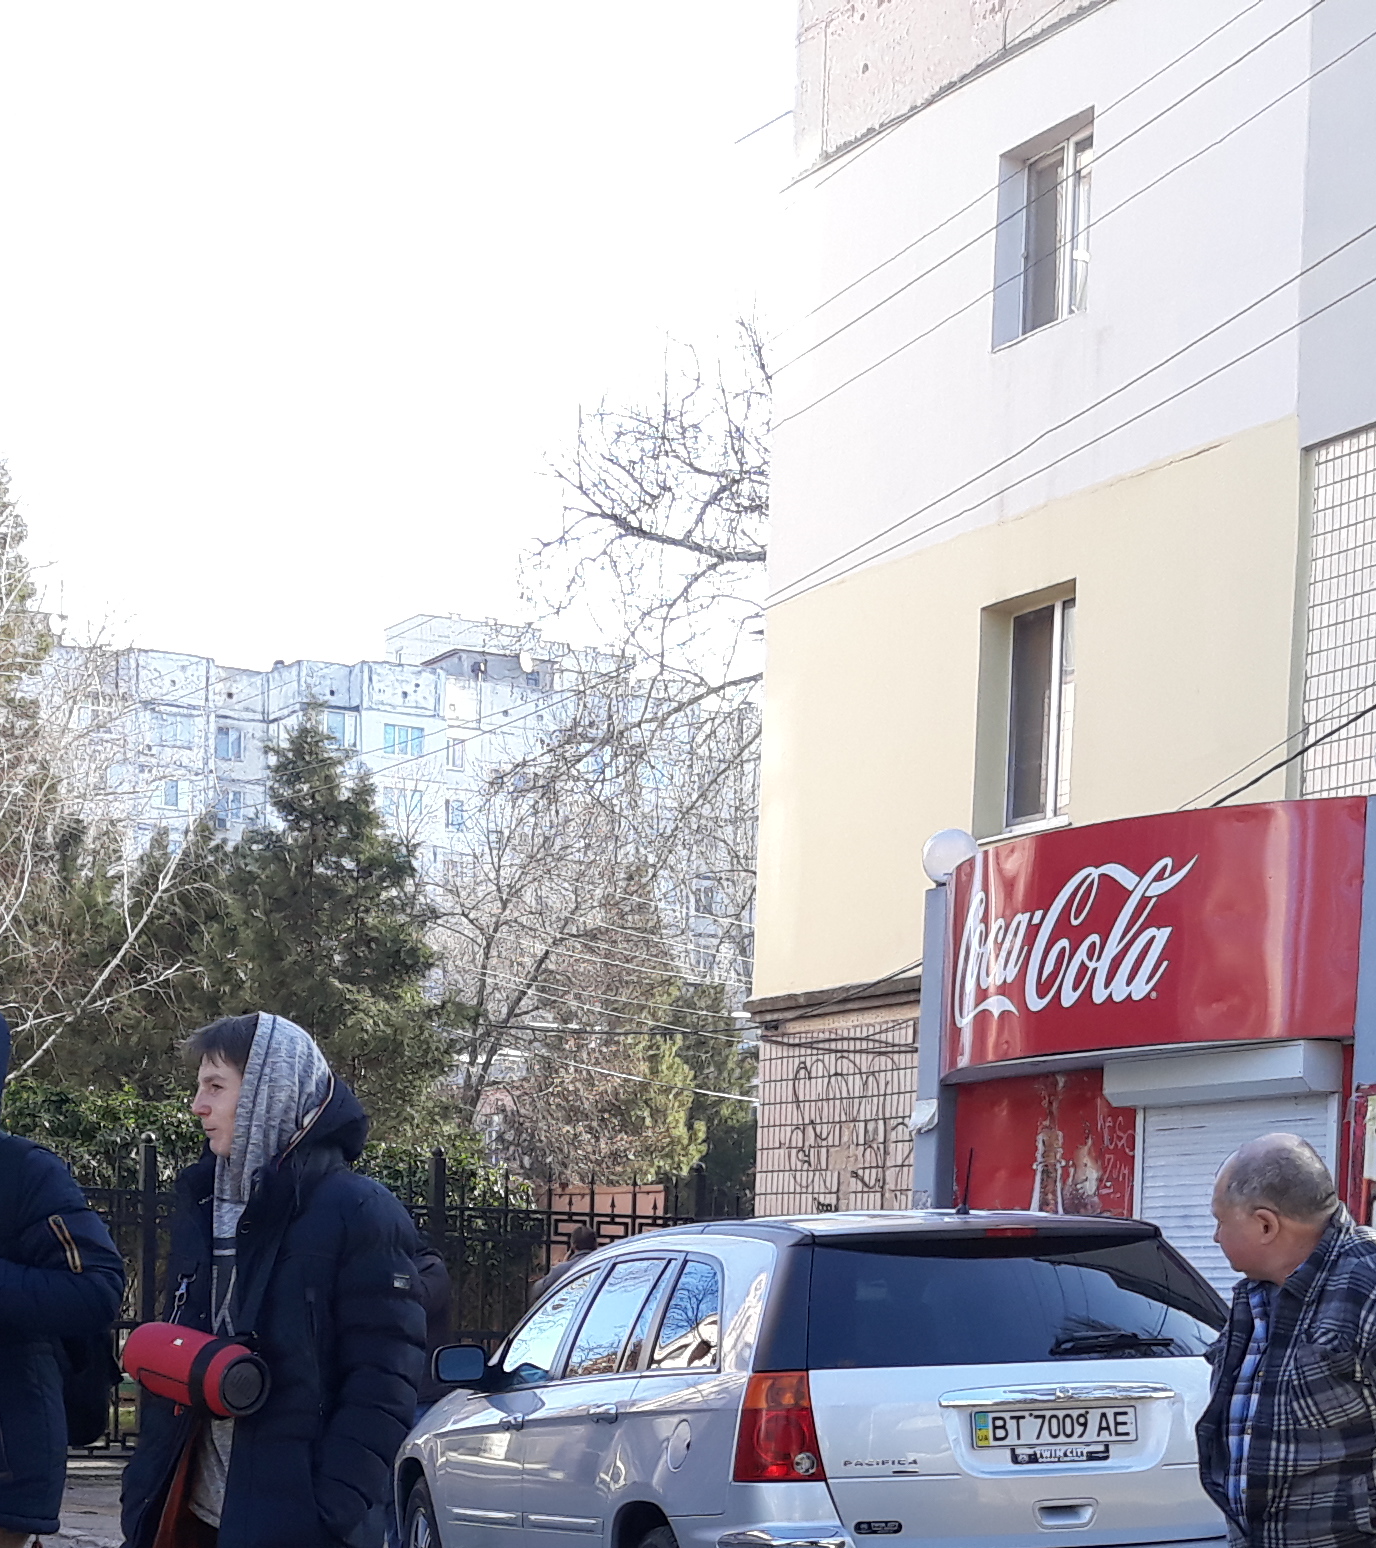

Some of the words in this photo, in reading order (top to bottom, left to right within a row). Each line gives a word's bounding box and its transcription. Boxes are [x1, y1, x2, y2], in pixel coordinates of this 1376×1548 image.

[953, 854, 1198, 1028] Coca-Cola
[1033, 1413, 1089, 1440] 7009
[1096, 1411, 1131, 1438] AE
